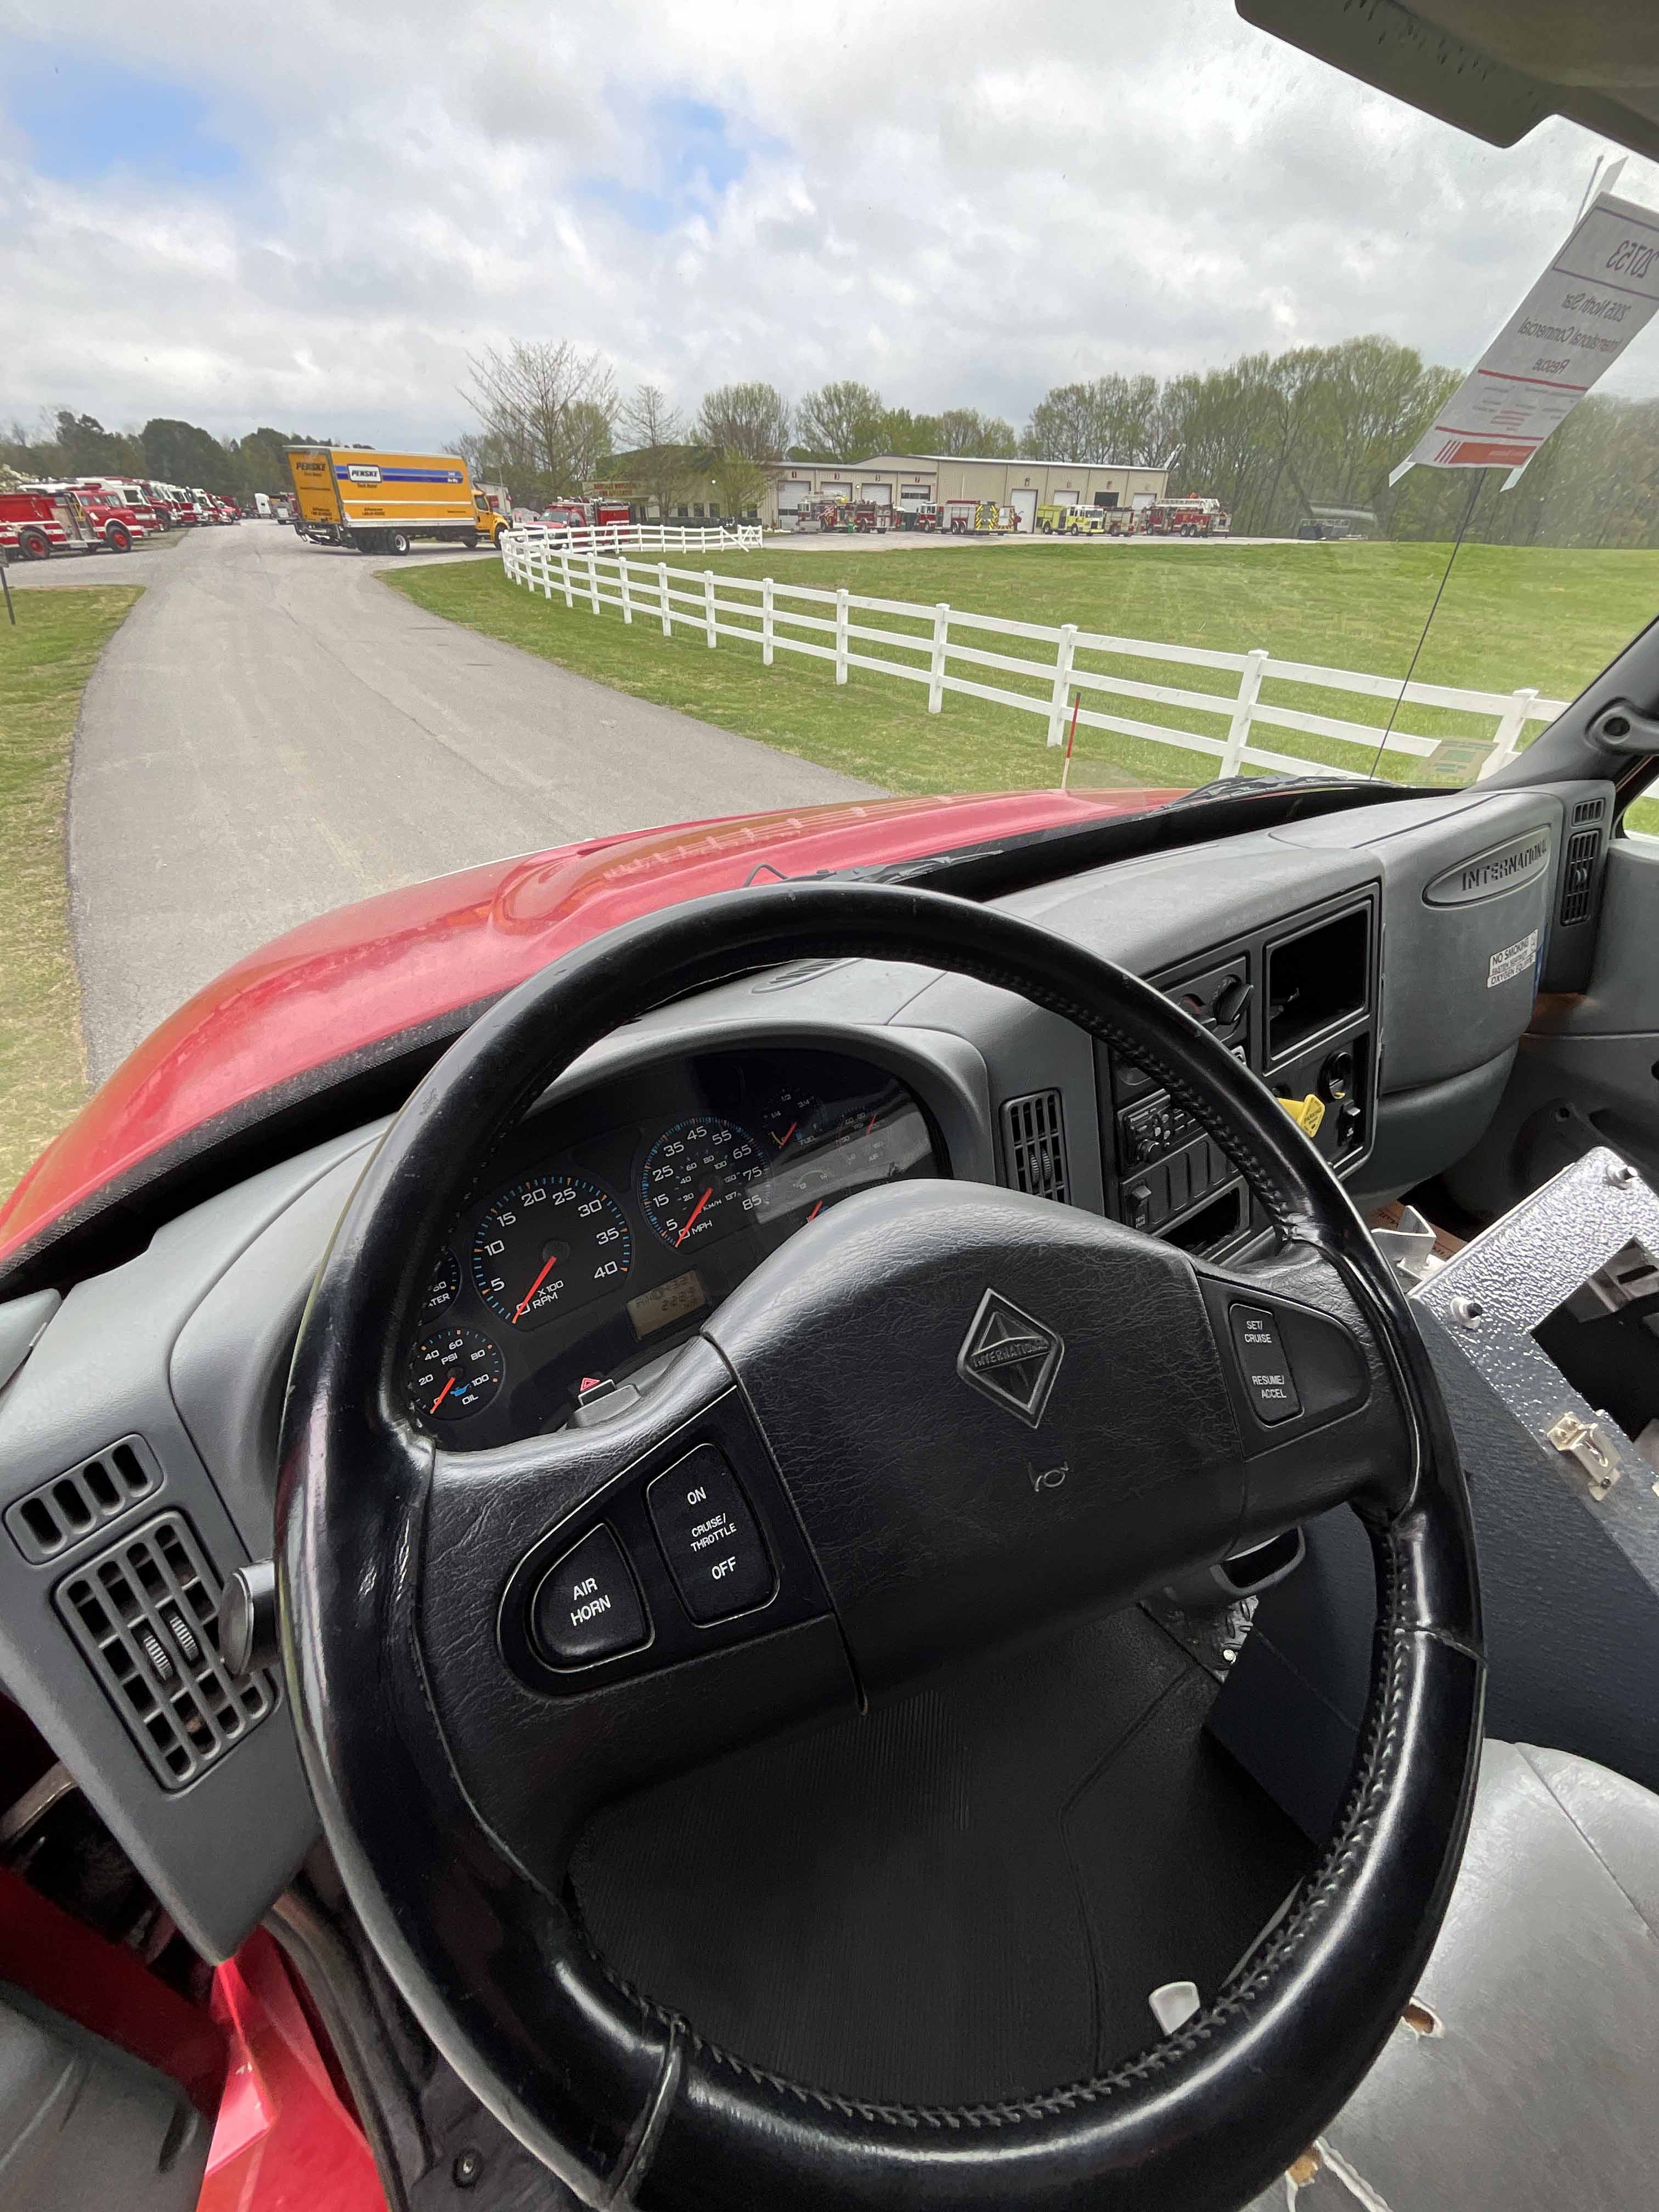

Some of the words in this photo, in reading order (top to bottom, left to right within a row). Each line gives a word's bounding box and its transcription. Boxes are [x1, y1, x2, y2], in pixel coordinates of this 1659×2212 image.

[1492, 952, 1503, 966] NO
[687, 1126, 707, 1140] 45
[712, 1130, 732, 1145] 55
[663, 1141, 685, 1157] 35
[733, 1144, 752, 1159] 65
[686, 1162, 697, 1171] 60
[703, 1155, 714, 1164] 80
[714, 1160, 727, 1170] 100
[652, 1165, 674, 1182] 25
[680, 1176, 692, 1184] 40
[724, 1174, 737, 1183] 120
[743, 1166, 762, 1181] 75
[521, 1188, 546, 1207] 20
[552, 1187, 577, 1205] 25
[653, 1193, 669, 1207] 15
[682, 1193, 694, 1201] 20
[725, 1191, 737, 1201] 137
[742, 1194, 762, 1211] 85
[578, 1199, 602, 1217] 30
[496, 1211, 516, 1227] 15
[666, 1218, 678, 1231] 5
[691, 1220, 713, 1235] MPH
[596, 1227, 619, 1245] 35
[484, 1240, 505, 1256] 10
[594, 1261, 618, 1279] 40
[490, 1277, 505, 1291] 5
[532, 1291, 558, 1309] RPM
[449, 1338, 464, 1350] 60
[1244, 1334, 1272, 1343] CRUISE
[424, 1350, 439, 1361] 40
[441, 1352, 458, 1365] PSI
[470, 1348, 486, 1361] 80
[418, 1374, 433, 1386] 20
[471, 1373, 489, 1387] 100
[461, 1394, 479, 1406] OIL
[1261, 1389, 1287, 1398] ACCEL
[687, 1487, 707, 1505] ON
[691, 1513, 727, 1537] CRUISE/
[690, 1522, 737, 1552] THROTTLE
[711, 1556, 737, 1580] OFF
[573, 1577, 599, 1601] AIR
[570, 1594, 612, 1627] HORN
